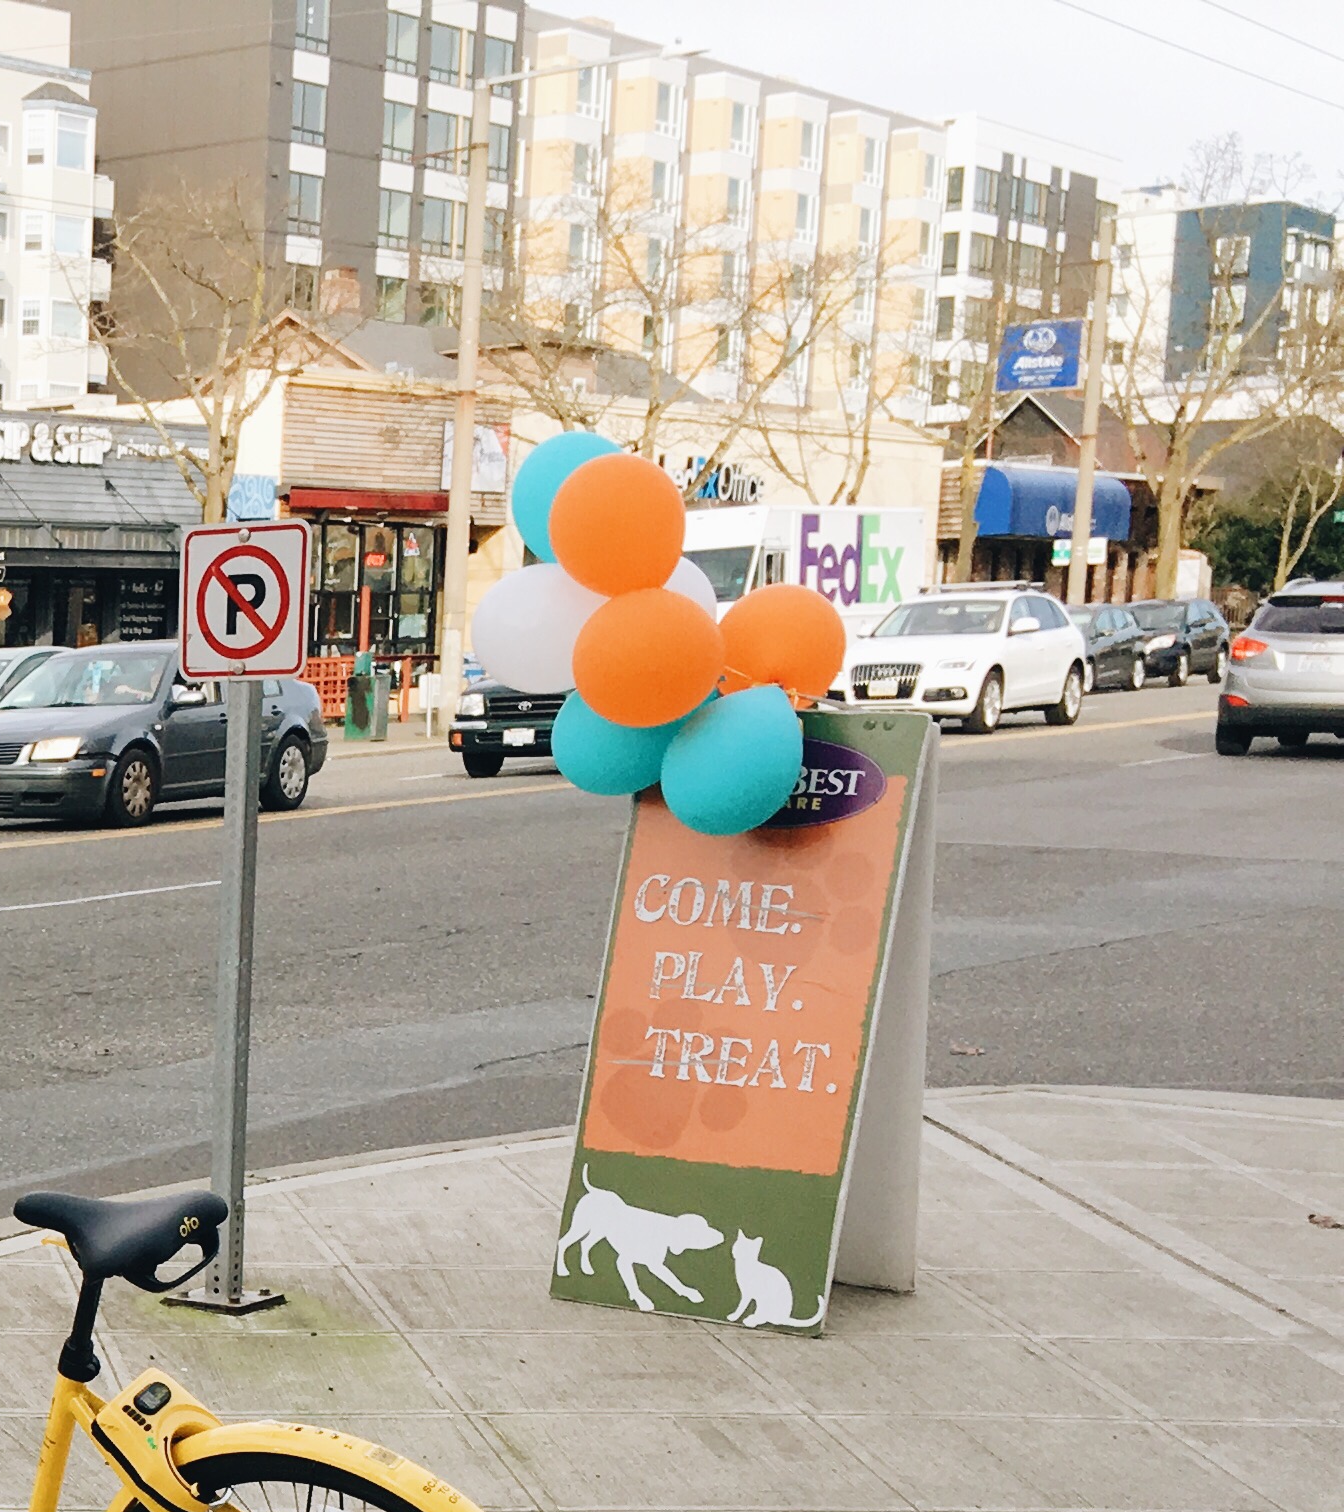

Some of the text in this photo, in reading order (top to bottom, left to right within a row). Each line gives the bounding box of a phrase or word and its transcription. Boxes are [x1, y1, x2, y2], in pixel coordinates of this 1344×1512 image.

[31, 422, 54, 462] &
[799, 514, 905, 606] FedEx
[634, 873, 802, 935] COME.
[649, 950, 804, 1012] PLAY.
[645, 1025, 837, 1094] TREAT.
[179, 1216, 200, 1238] ofo
